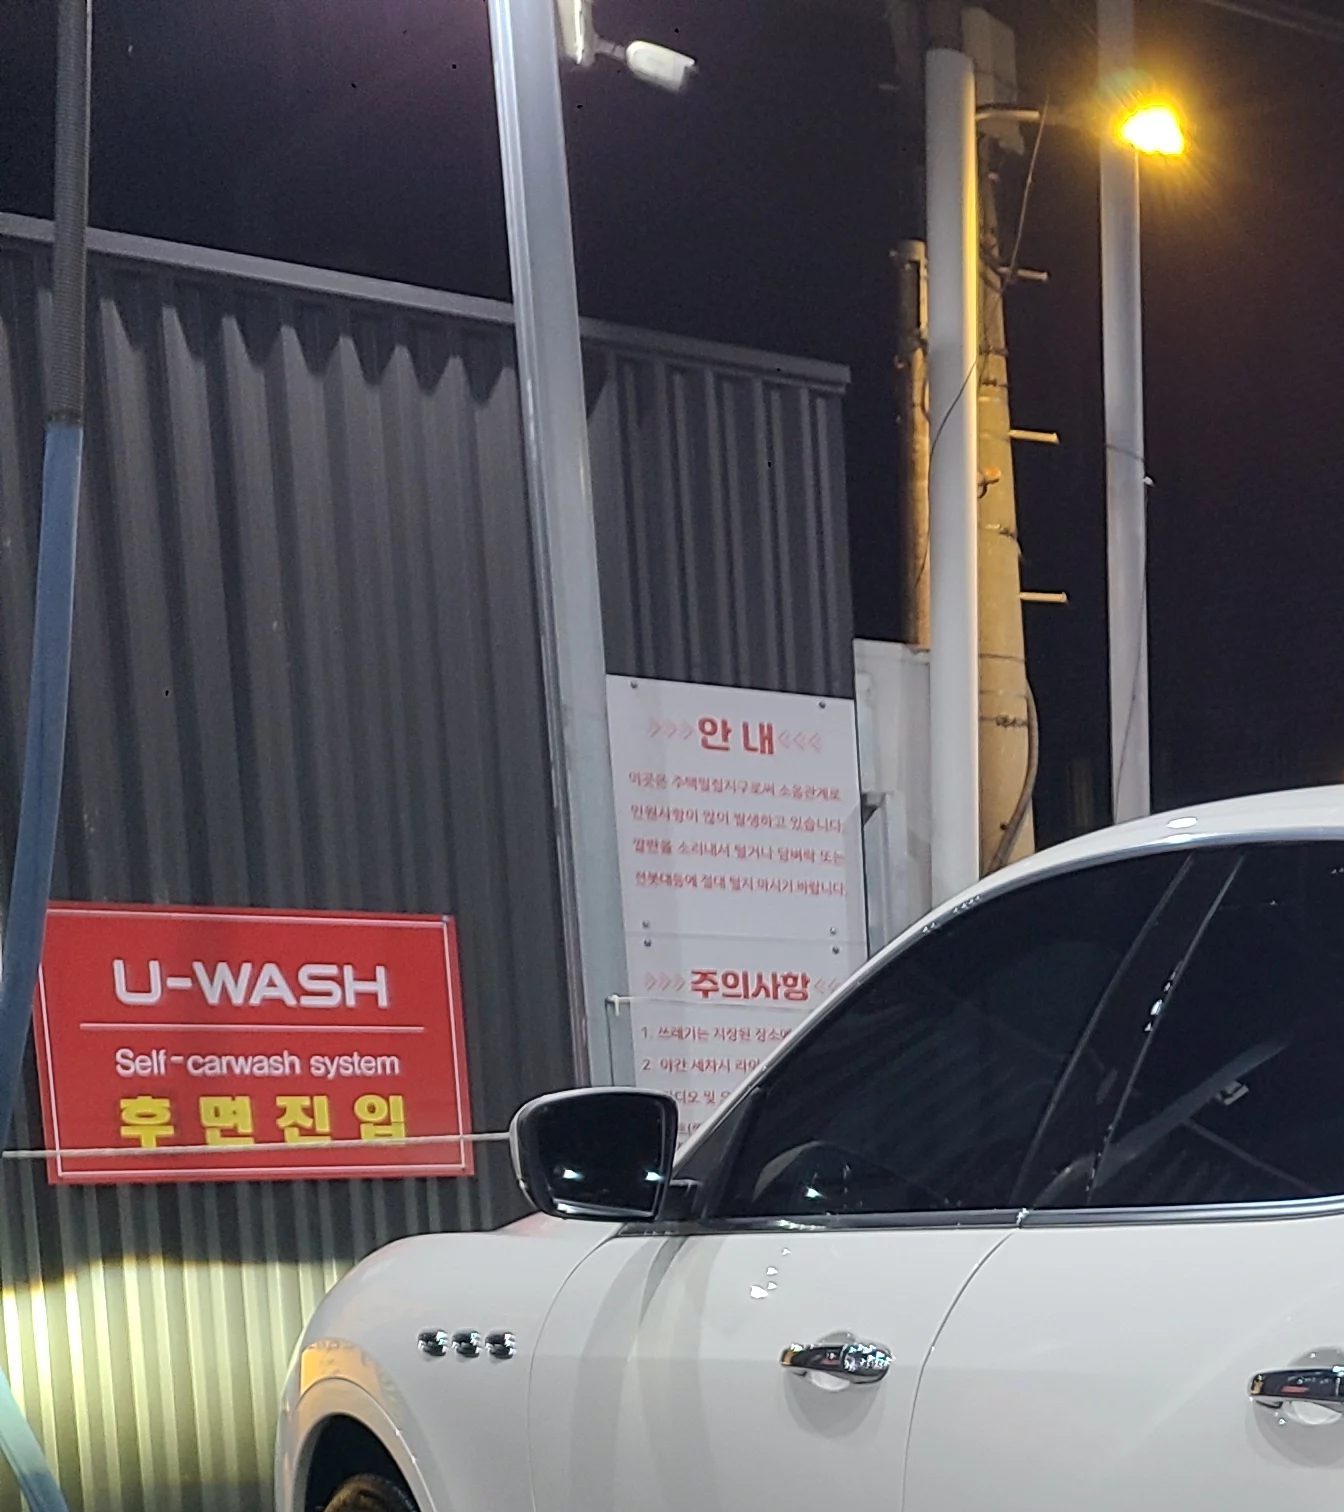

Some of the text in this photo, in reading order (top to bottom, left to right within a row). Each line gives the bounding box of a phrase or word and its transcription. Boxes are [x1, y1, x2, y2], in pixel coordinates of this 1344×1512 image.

[733, 812, 785, 829] 발생하고
[677, 840, 730, 859] 소리내서
[734, 844, 773, 861] 털거나
[820, 849, 845, 868] 또는
[700, 873, 726, 890] 절대
[729, 876, 753, 892] 털지
[757, 876, 793, 894] 마시기
[112, 958, 390, 1009] U-WASH
[690, 968, 811, 1001] 주의사항
[658, 1026, 709, 1041] 쓰레기는
[309, 1050, 402, 1080] system
[660, 1058, 687, 1073] 야간
[691, 1059, 731, 1074] 세차시
